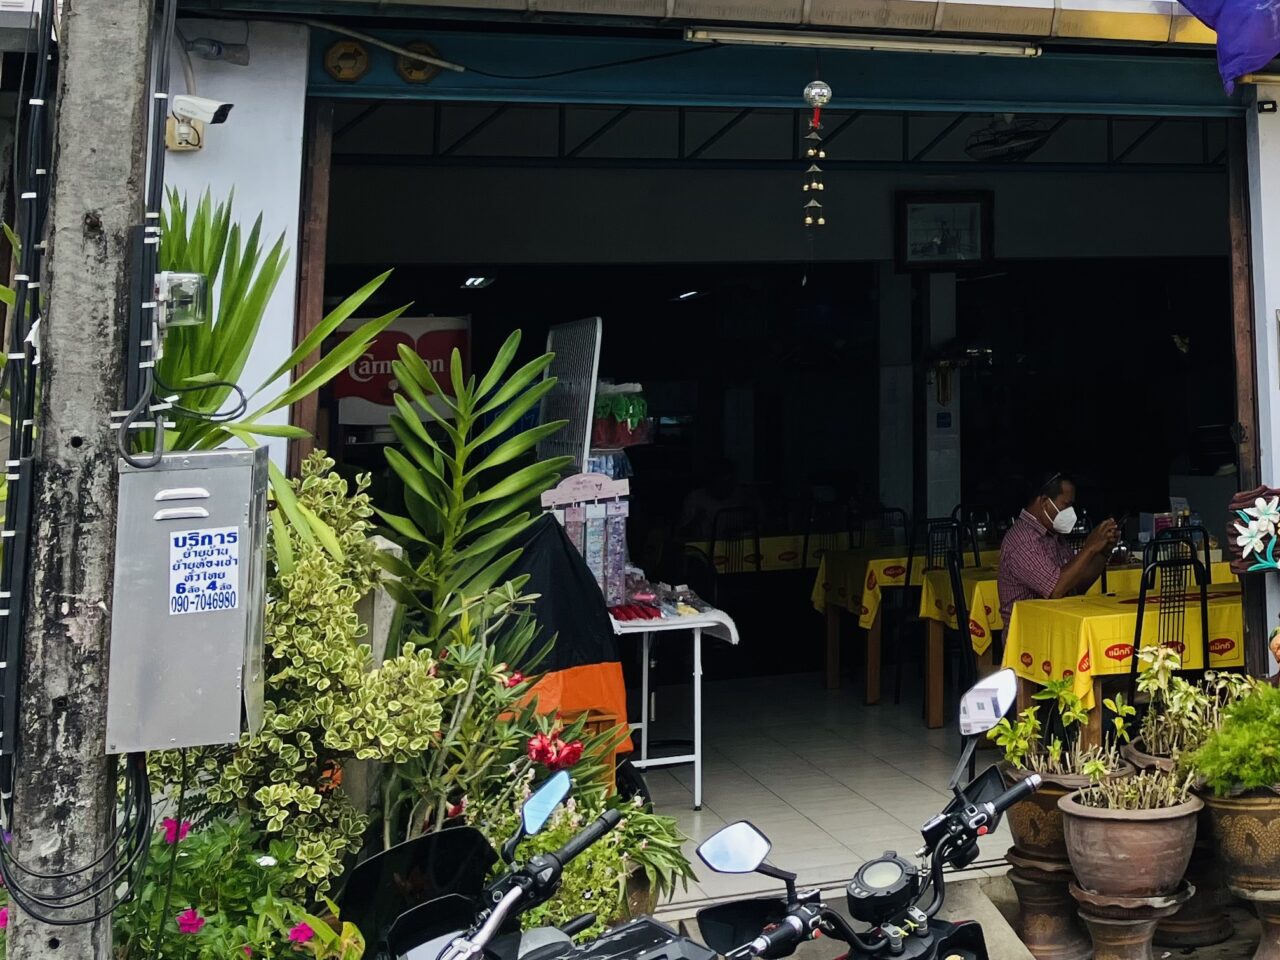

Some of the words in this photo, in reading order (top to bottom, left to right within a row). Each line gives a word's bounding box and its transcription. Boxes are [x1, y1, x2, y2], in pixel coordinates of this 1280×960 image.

[173, 531, 237, 548] บริการ
[175, 582, 187, 595] 6
[206, 580, 218, 591] 4
[171, 591, 237, 613] 090-7046980
